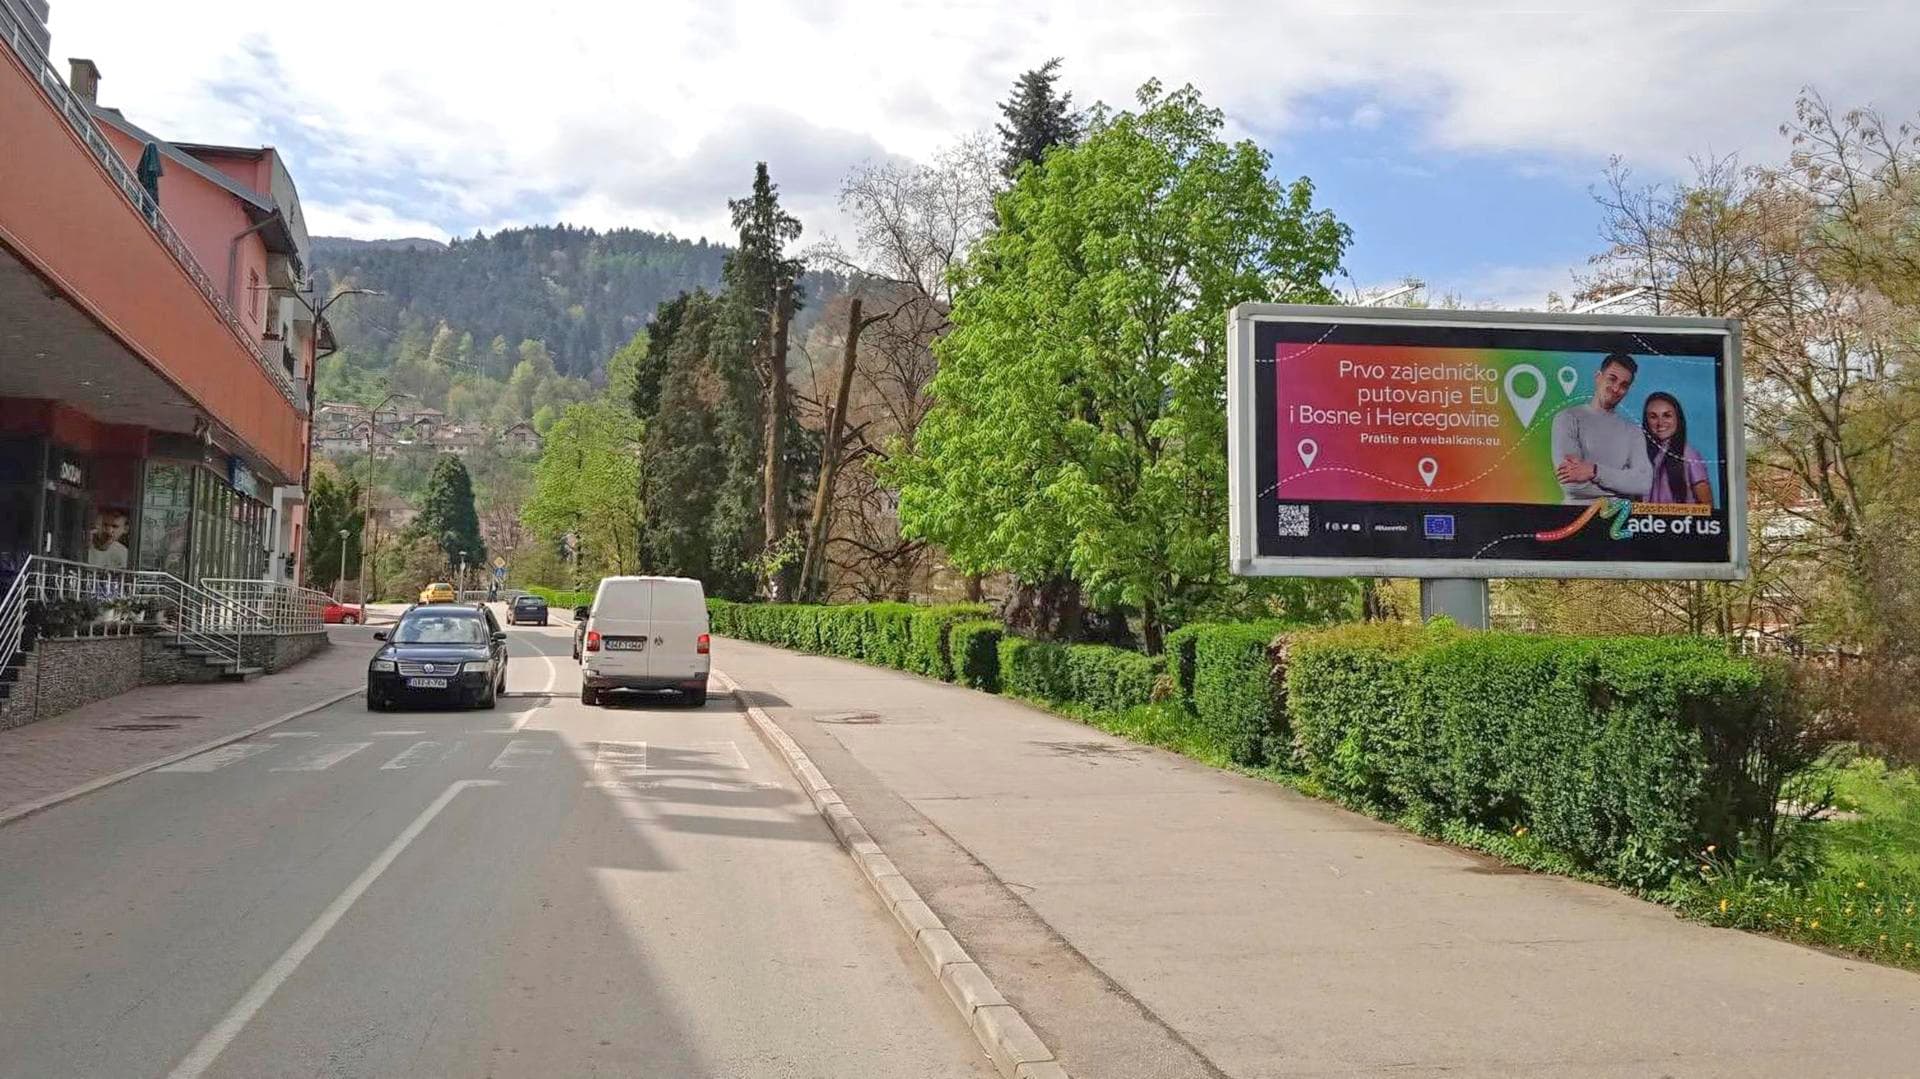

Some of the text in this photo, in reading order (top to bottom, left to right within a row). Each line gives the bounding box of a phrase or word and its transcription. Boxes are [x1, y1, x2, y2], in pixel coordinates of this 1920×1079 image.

[1339, 360, 1498, 384] Prvo zajedničko
[1358, 386, 1499, 407] putovanje EU
[1289, 405, 1499, 431] i Bosne i Hercegovine
[1360, 432, 1500, 446] Pratite na webalkans.eu
[1670, 516, 1693, 534] of
[1696, 519, 1721, 535] us
